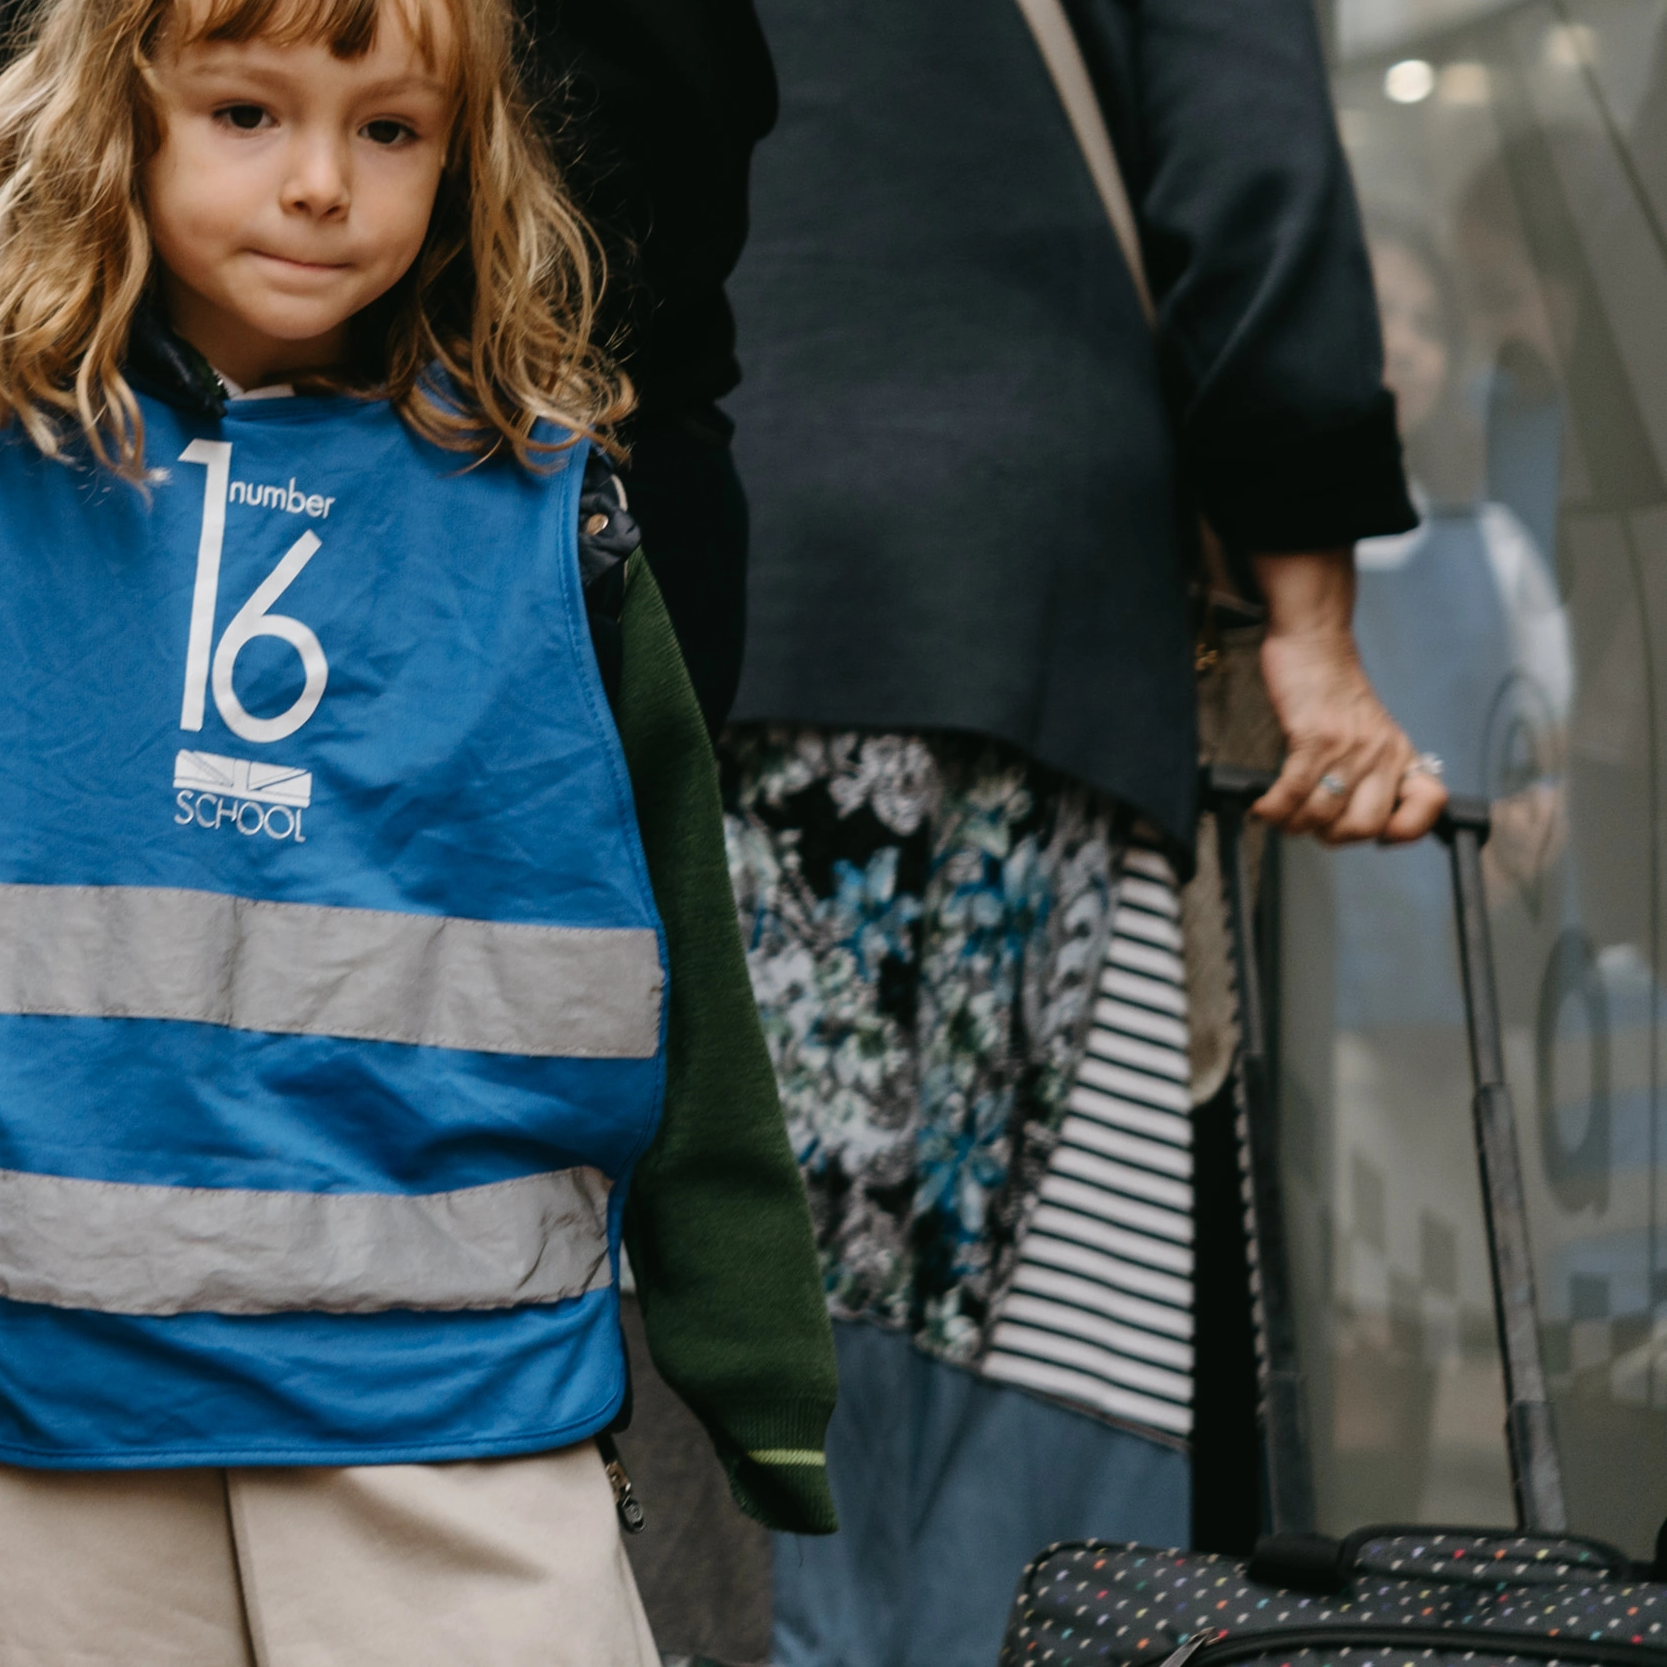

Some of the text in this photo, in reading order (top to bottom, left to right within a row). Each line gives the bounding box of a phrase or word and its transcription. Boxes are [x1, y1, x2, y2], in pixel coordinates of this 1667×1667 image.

[229, 477, 336, 519] number
[177, 437, 329, 744] 16
[173, 789, 307, 843] SCHOOL
